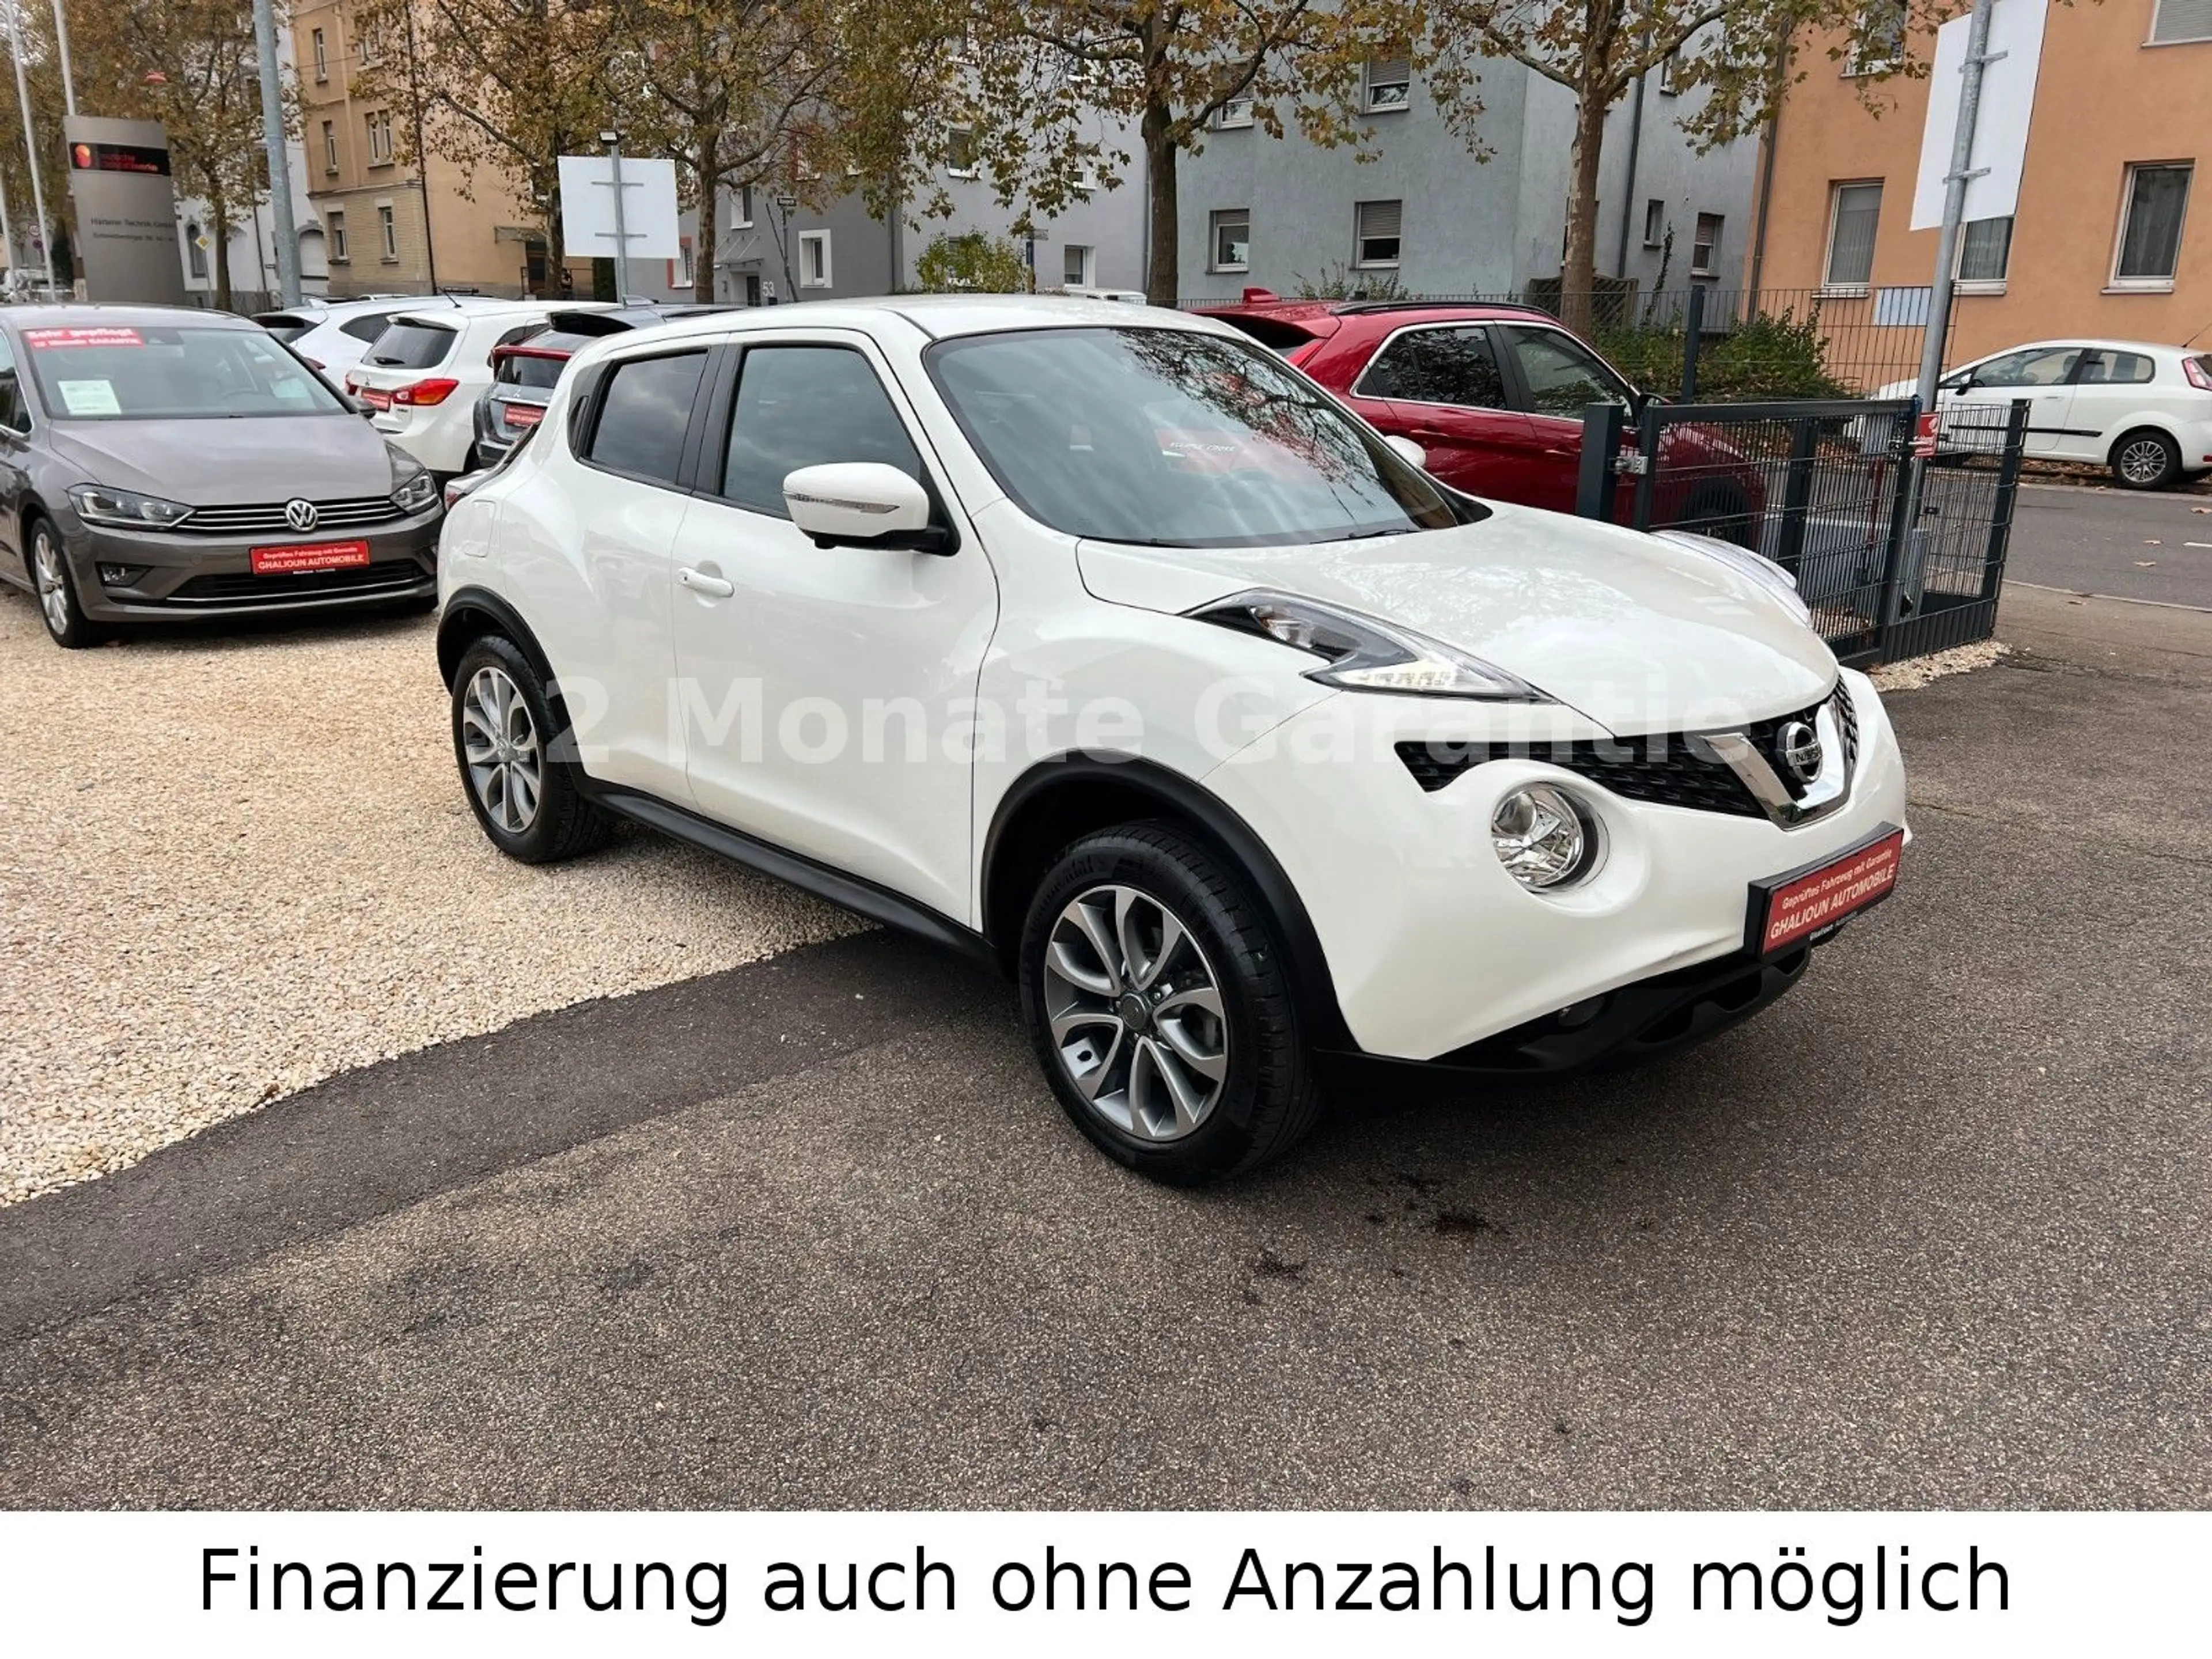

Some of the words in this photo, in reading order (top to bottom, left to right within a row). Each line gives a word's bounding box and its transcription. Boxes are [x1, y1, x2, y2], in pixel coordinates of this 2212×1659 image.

[762, 281, 775, 297] 53
[308, 554, 365, 567] AUTOMOBILE
[1770, 897, 1830, 940] GHALIOUN
[1830, 863, 1895, 911] AUTOMOBILE
